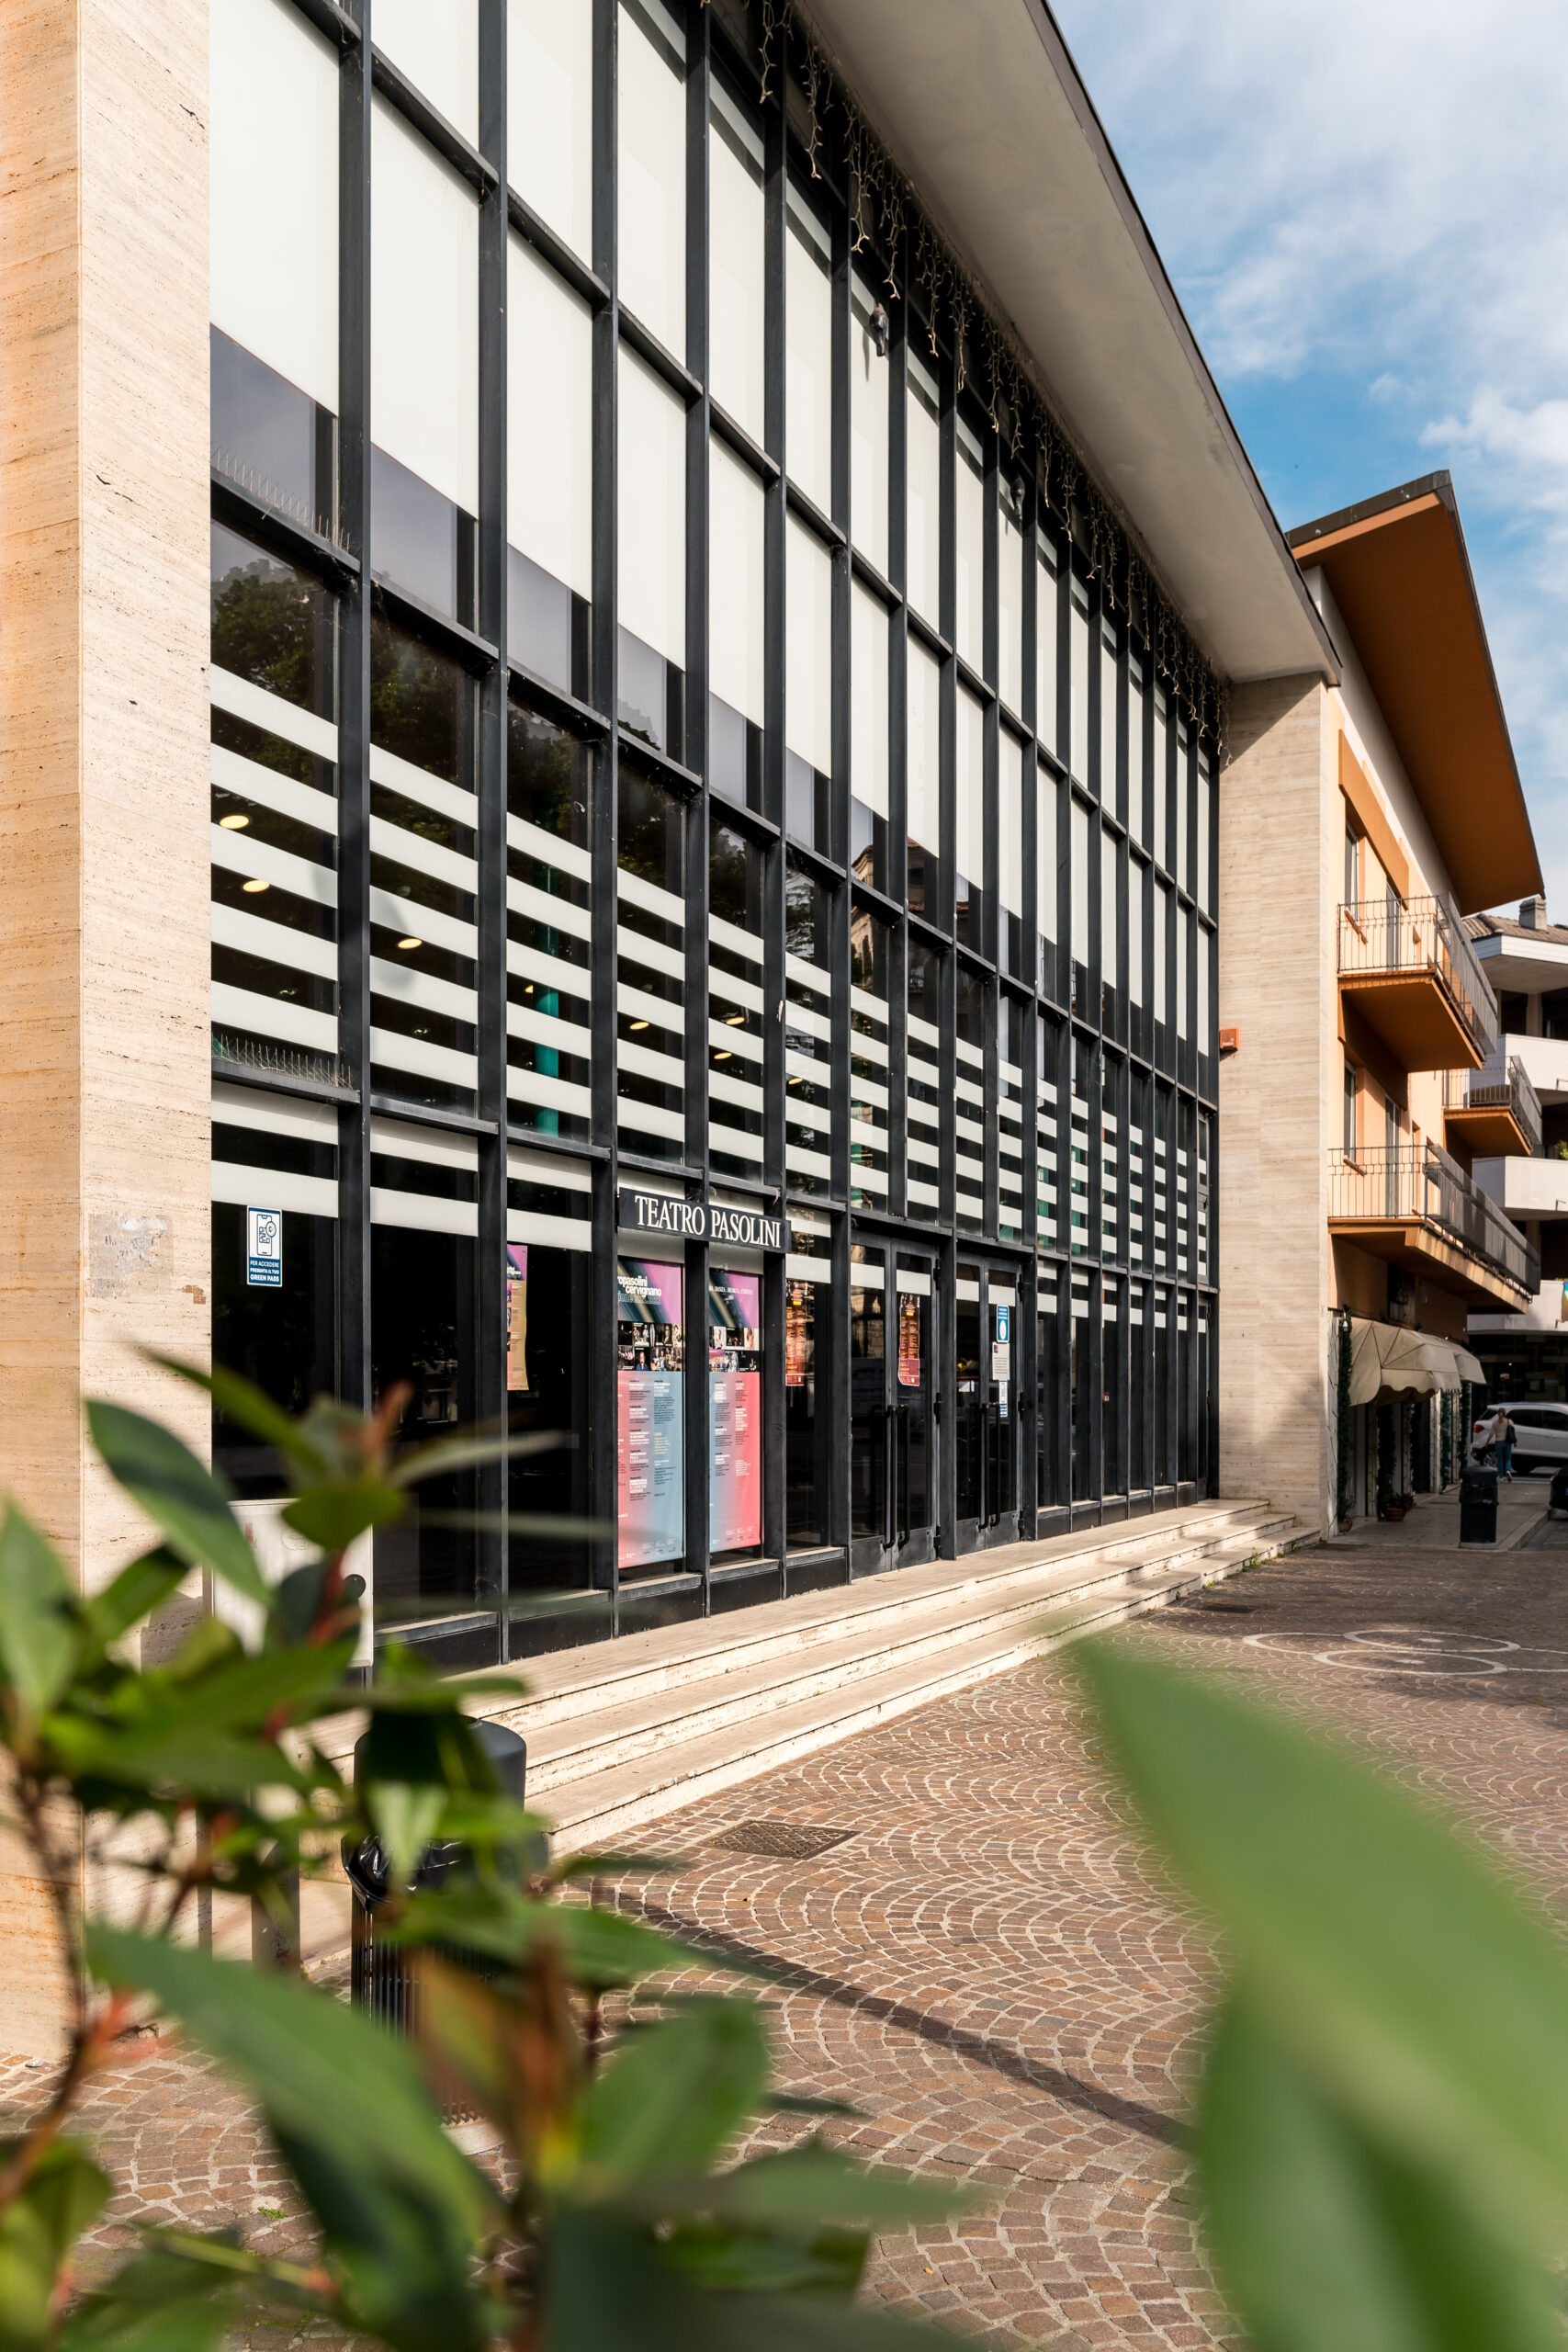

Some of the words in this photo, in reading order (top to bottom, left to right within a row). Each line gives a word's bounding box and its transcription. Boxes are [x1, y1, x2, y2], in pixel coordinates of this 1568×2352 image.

[634, 1195, 705, 1236] TEATRO
[710, 1209, 781, 1249] PASOLINI
[625, 1285, 661, 1297] cervignano
